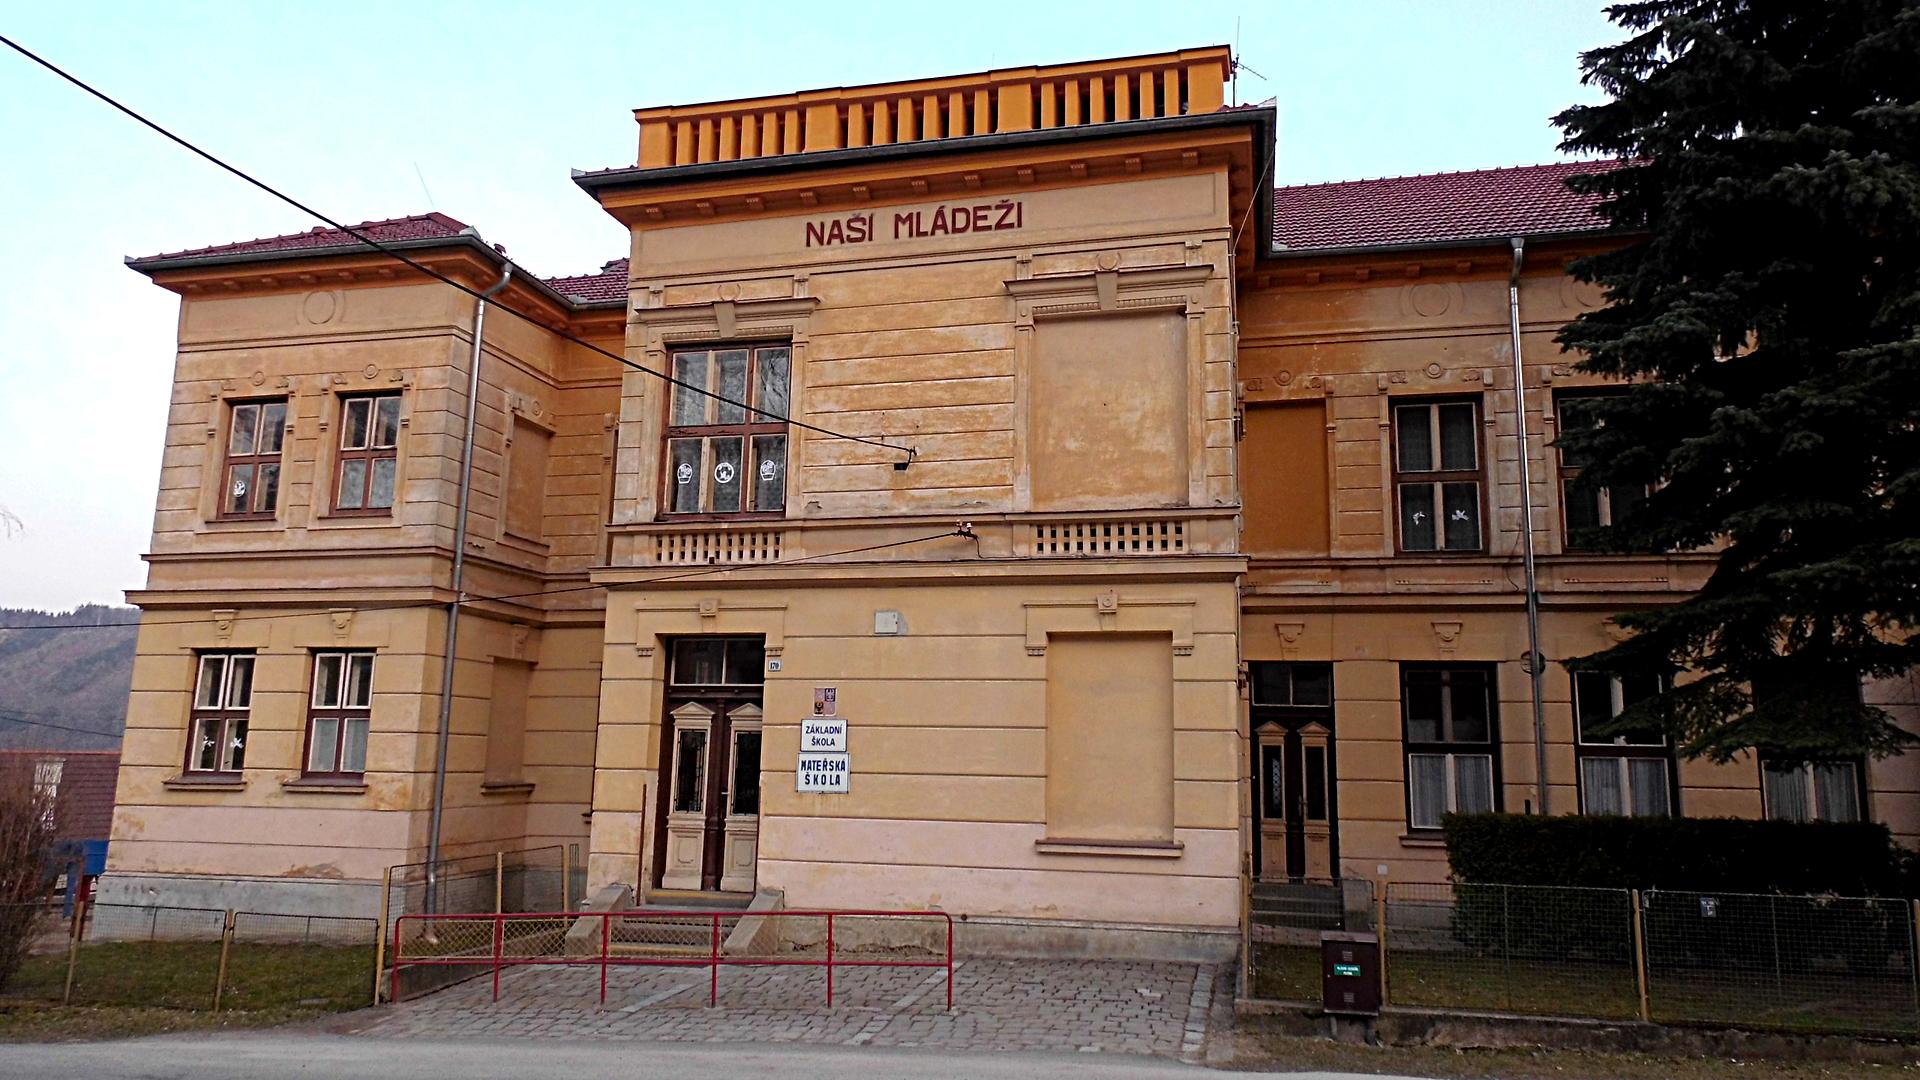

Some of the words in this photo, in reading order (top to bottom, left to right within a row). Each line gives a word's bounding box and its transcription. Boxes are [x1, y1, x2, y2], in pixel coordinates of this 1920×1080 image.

[894, 199, 1022, 239] MLÁDEŽI
[805, 724, 842, 734] ZÁKLADNÍ
[811, 736, 835, 746] ŠKOLA
[801, 758, 846, 771] MATEŘSKÁ
